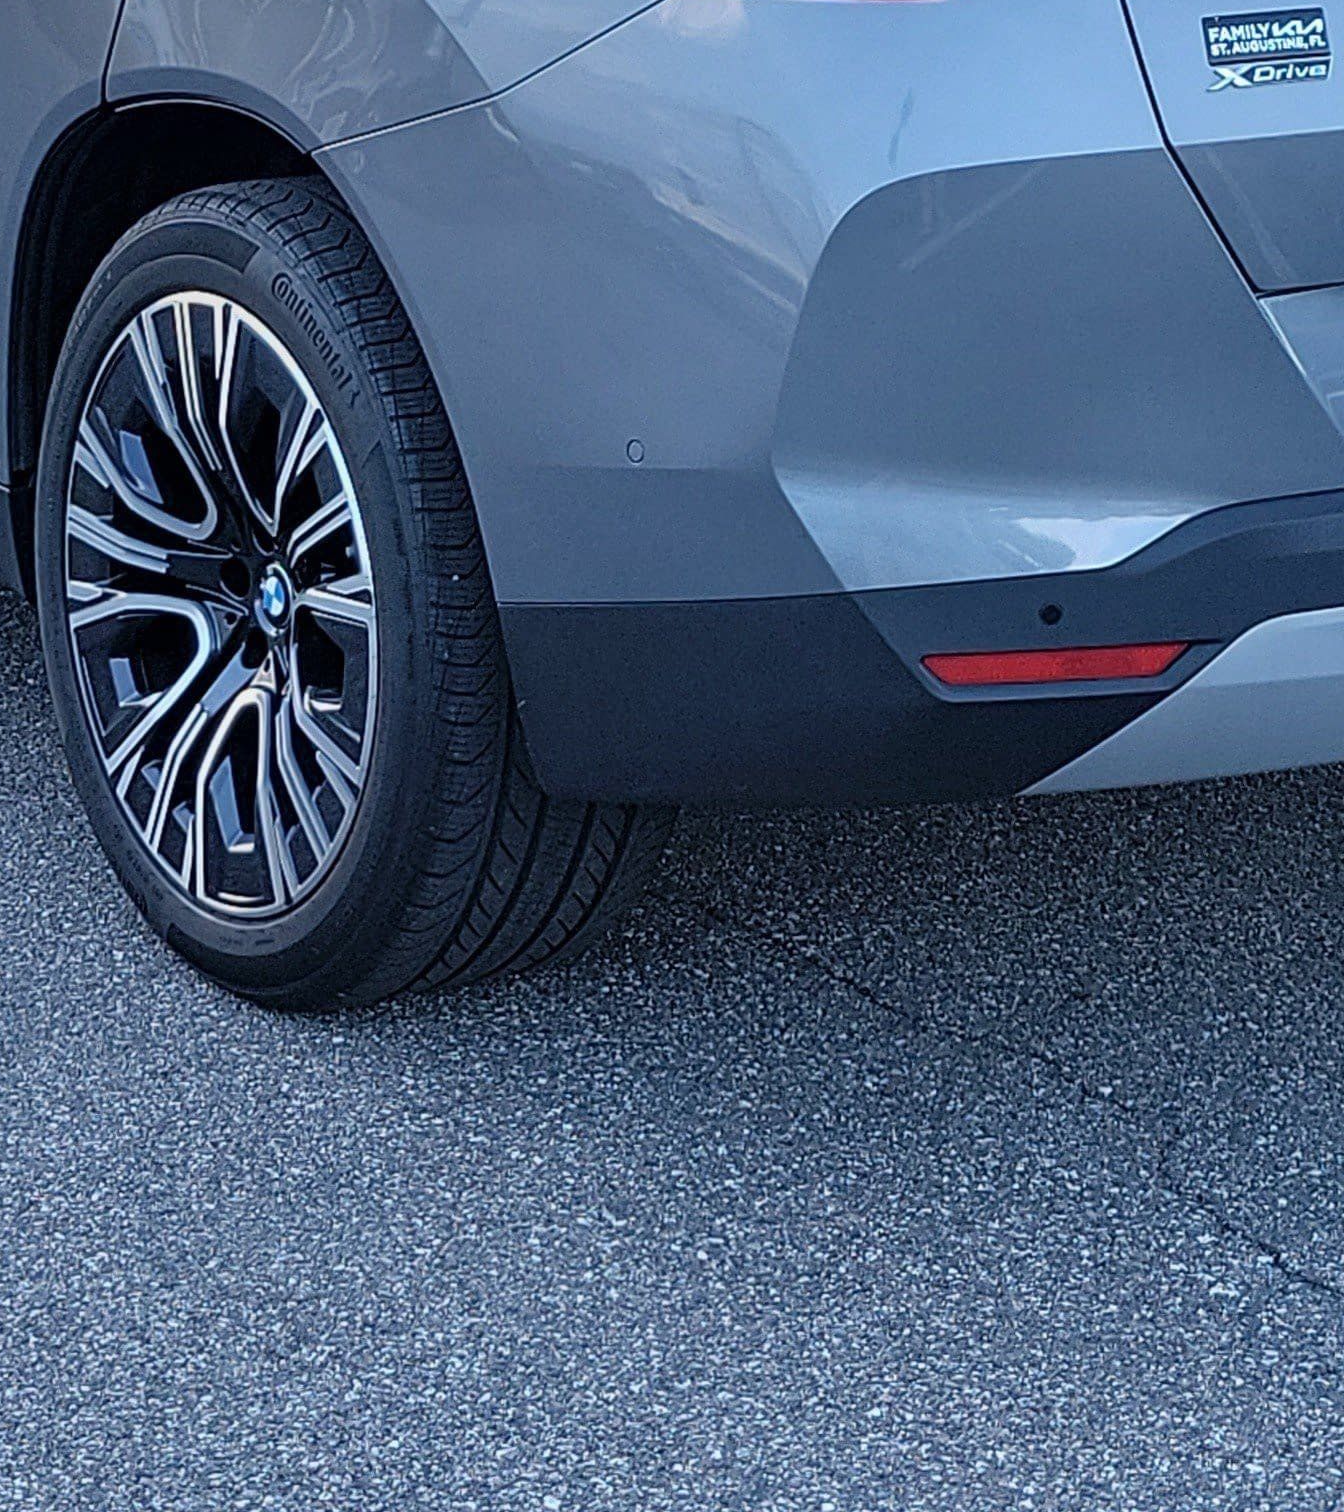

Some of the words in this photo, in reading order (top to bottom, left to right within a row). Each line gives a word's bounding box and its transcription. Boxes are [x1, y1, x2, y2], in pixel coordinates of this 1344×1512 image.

[1207, 22, 1270, 43] FAMILY
[1210, 43, 1231, 56] ST.
[1309, 35, 1326, 47] FL
[270, 272, 354, 390] Continental
